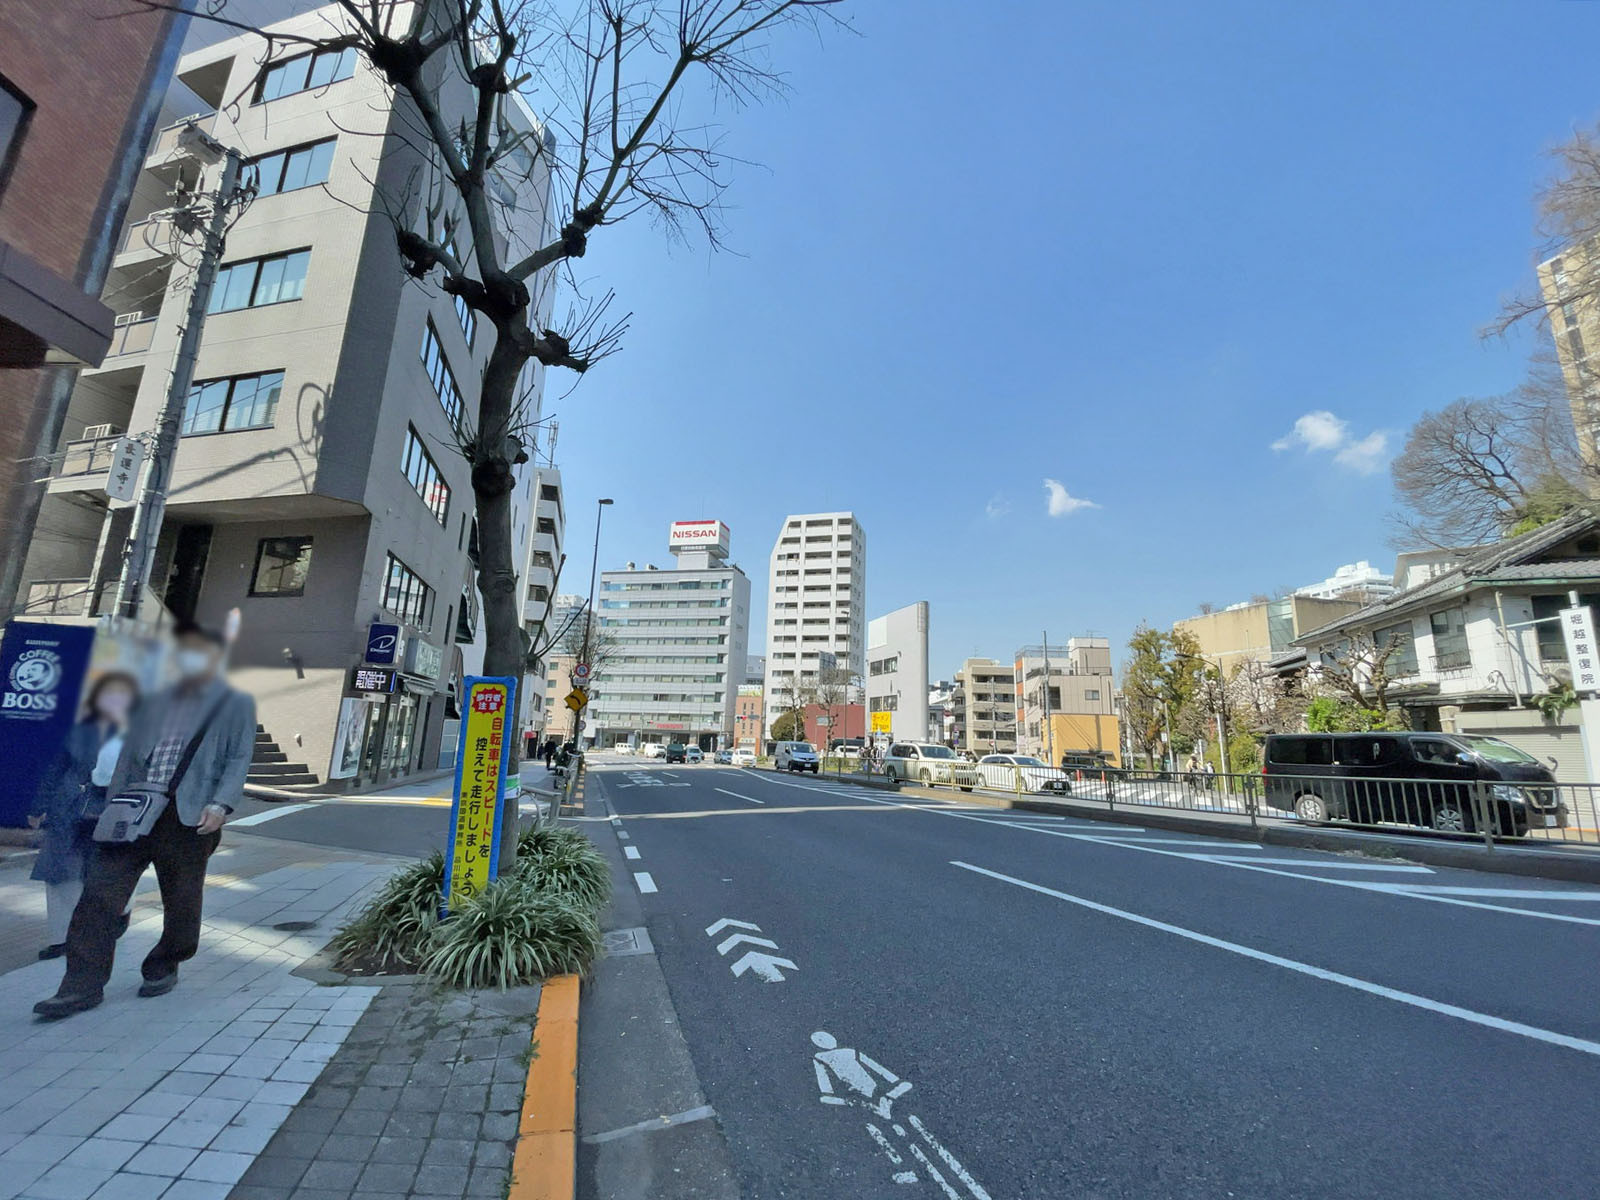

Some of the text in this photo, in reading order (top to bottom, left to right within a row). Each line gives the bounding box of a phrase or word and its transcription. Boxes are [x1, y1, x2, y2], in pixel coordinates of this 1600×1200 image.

[672, 529, 717, 538] NISSAN
[18, 649, 61, 662] COFFEE
[1570, 613, 1595, 685] 堀越整復院
[2, 692, 57, 710] BOSS
[476, 693, 502, 702] 歩行者
[478, 702, 498, 710] 注意
[479, 717, 503, 858] 自転車はスピードを
[461, 737, 488, 897] 控えて走行しましょう
